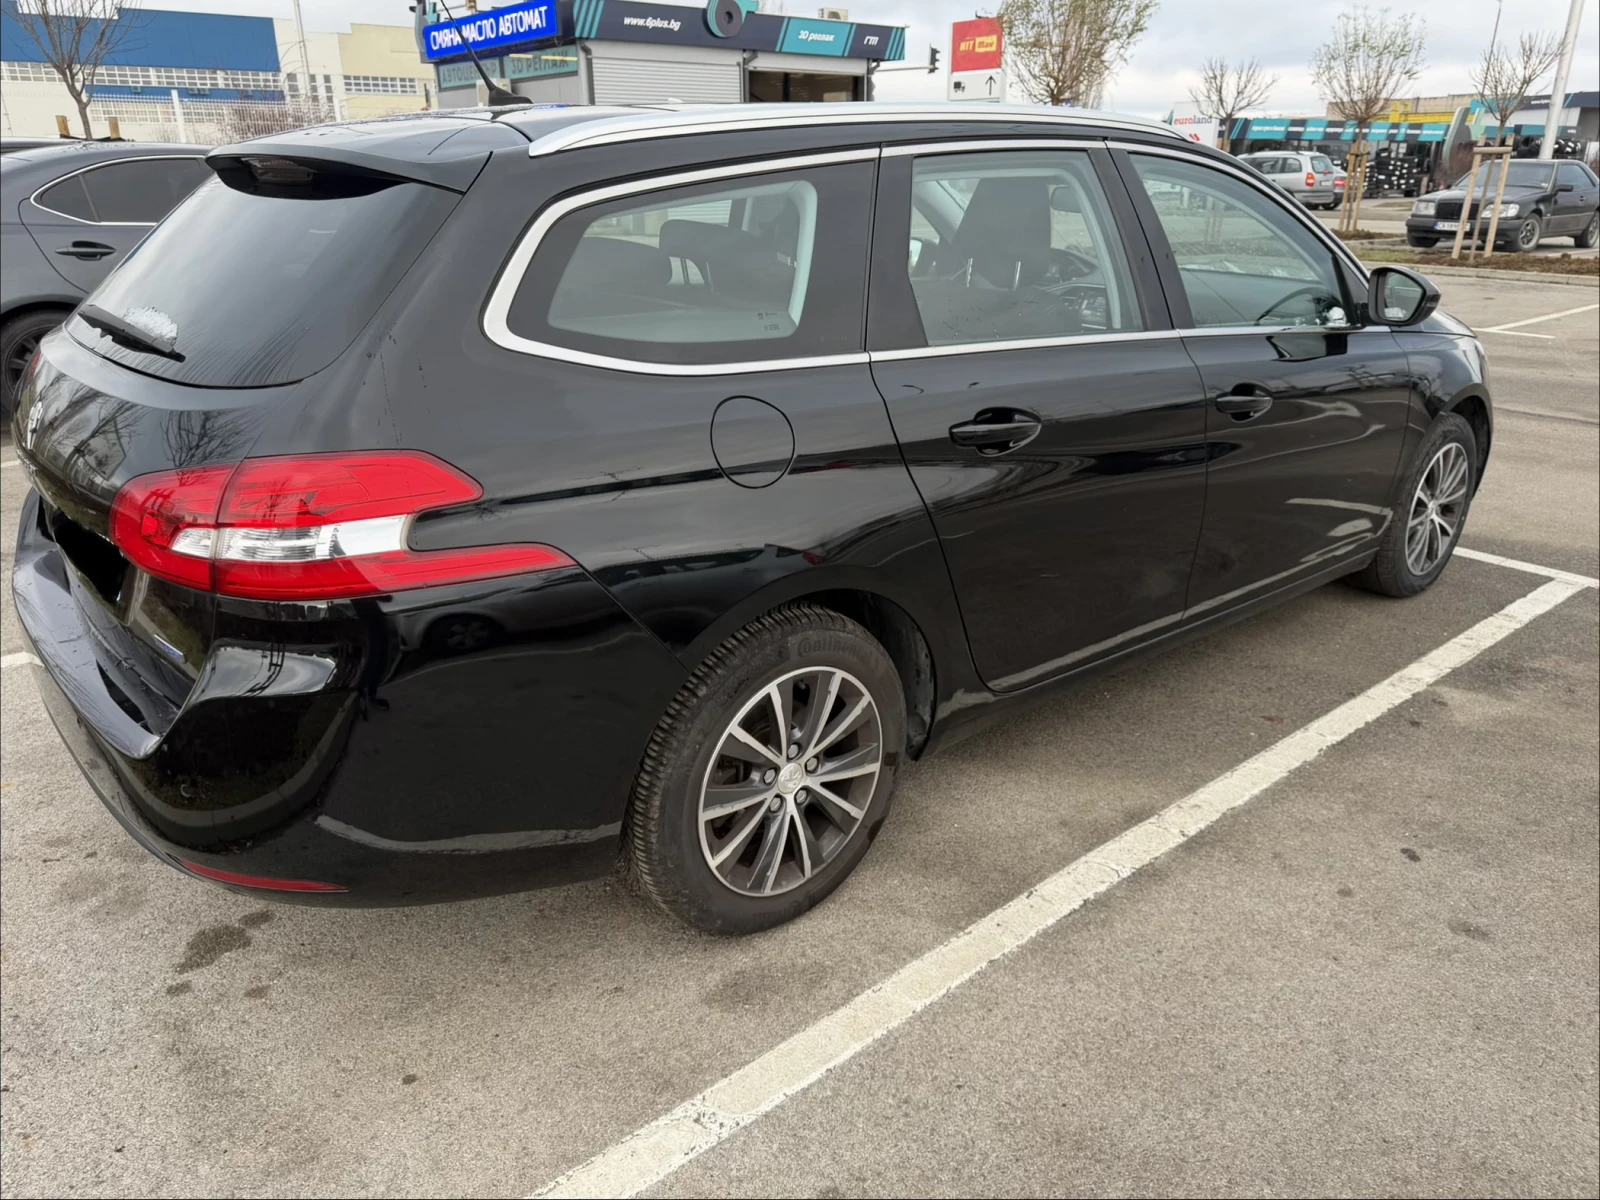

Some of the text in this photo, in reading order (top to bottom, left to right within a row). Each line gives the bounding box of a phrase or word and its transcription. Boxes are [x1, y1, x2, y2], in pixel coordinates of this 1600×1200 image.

[461, 18, 497, 43] МАСЛО
[498, 6, 548, 36] АВТОМАТ
[623, 16, 682, 32] www.6plus.bg
[798, 30, 809, 40] 3D
[442, 62, 497, 84] АВТОЦЕНЪР
[1173, 114, 1213, 126] euroland
[797, 635, 877, 663] Continen
